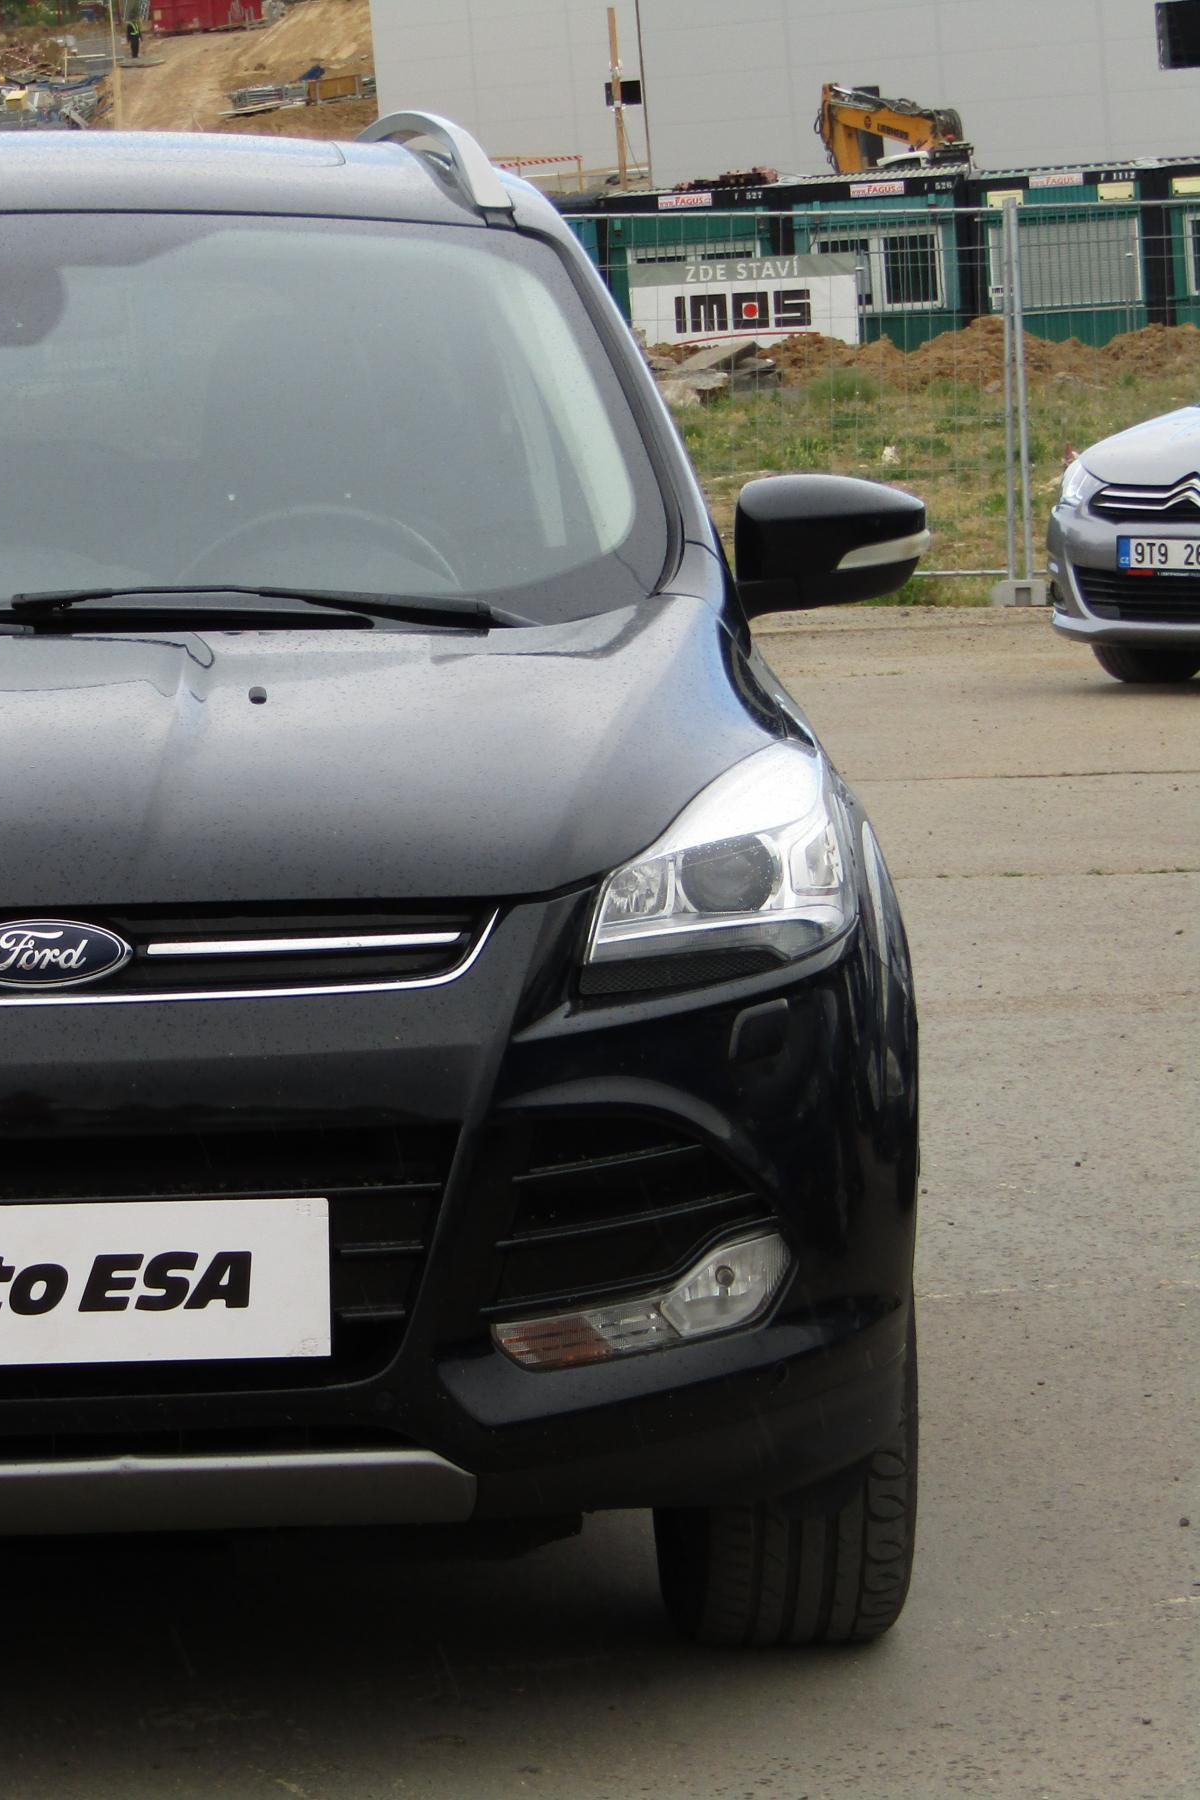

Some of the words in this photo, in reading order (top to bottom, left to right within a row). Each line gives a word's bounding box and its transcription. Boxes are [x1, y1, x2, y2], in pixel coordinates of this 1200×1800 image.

[685, 265, 727, 283] ZDE
[736, 256, 799, 280] STAVÍ
[1135, 542, 1168, 565] 9T9
[77, 1251, 252, 1313] ESA
